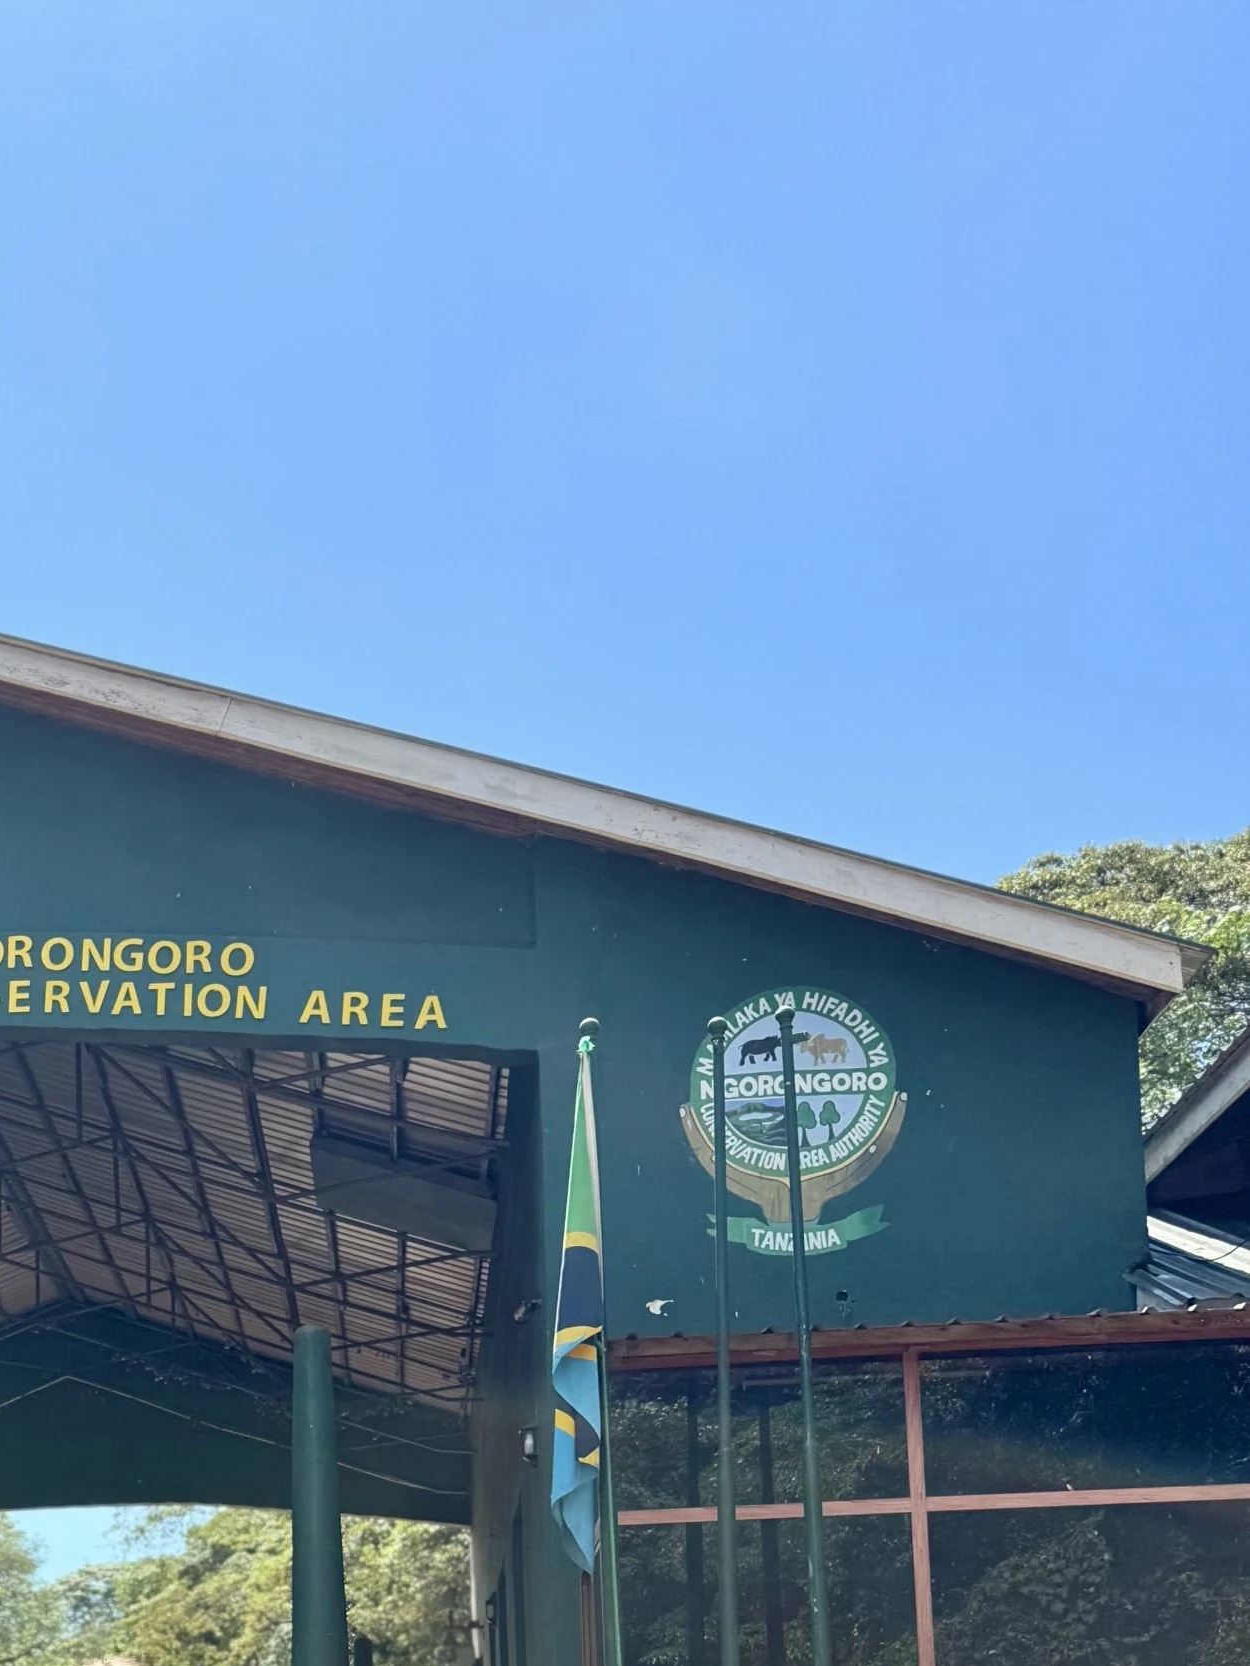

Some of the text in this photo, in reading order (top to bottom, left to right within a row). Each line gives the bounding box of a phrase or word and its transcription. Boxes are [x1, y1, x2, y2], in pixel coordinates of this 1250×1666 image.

[299, 990, 447, 1030] AREA
[696, 991, 889, 1076] MLAKA YA HIFADHI YA
[799, 1148, 830, 1169] REA
[828, 1094, 886, 1162] AUTHORITY
[751, 1227, 842, 1252] TANNIA
